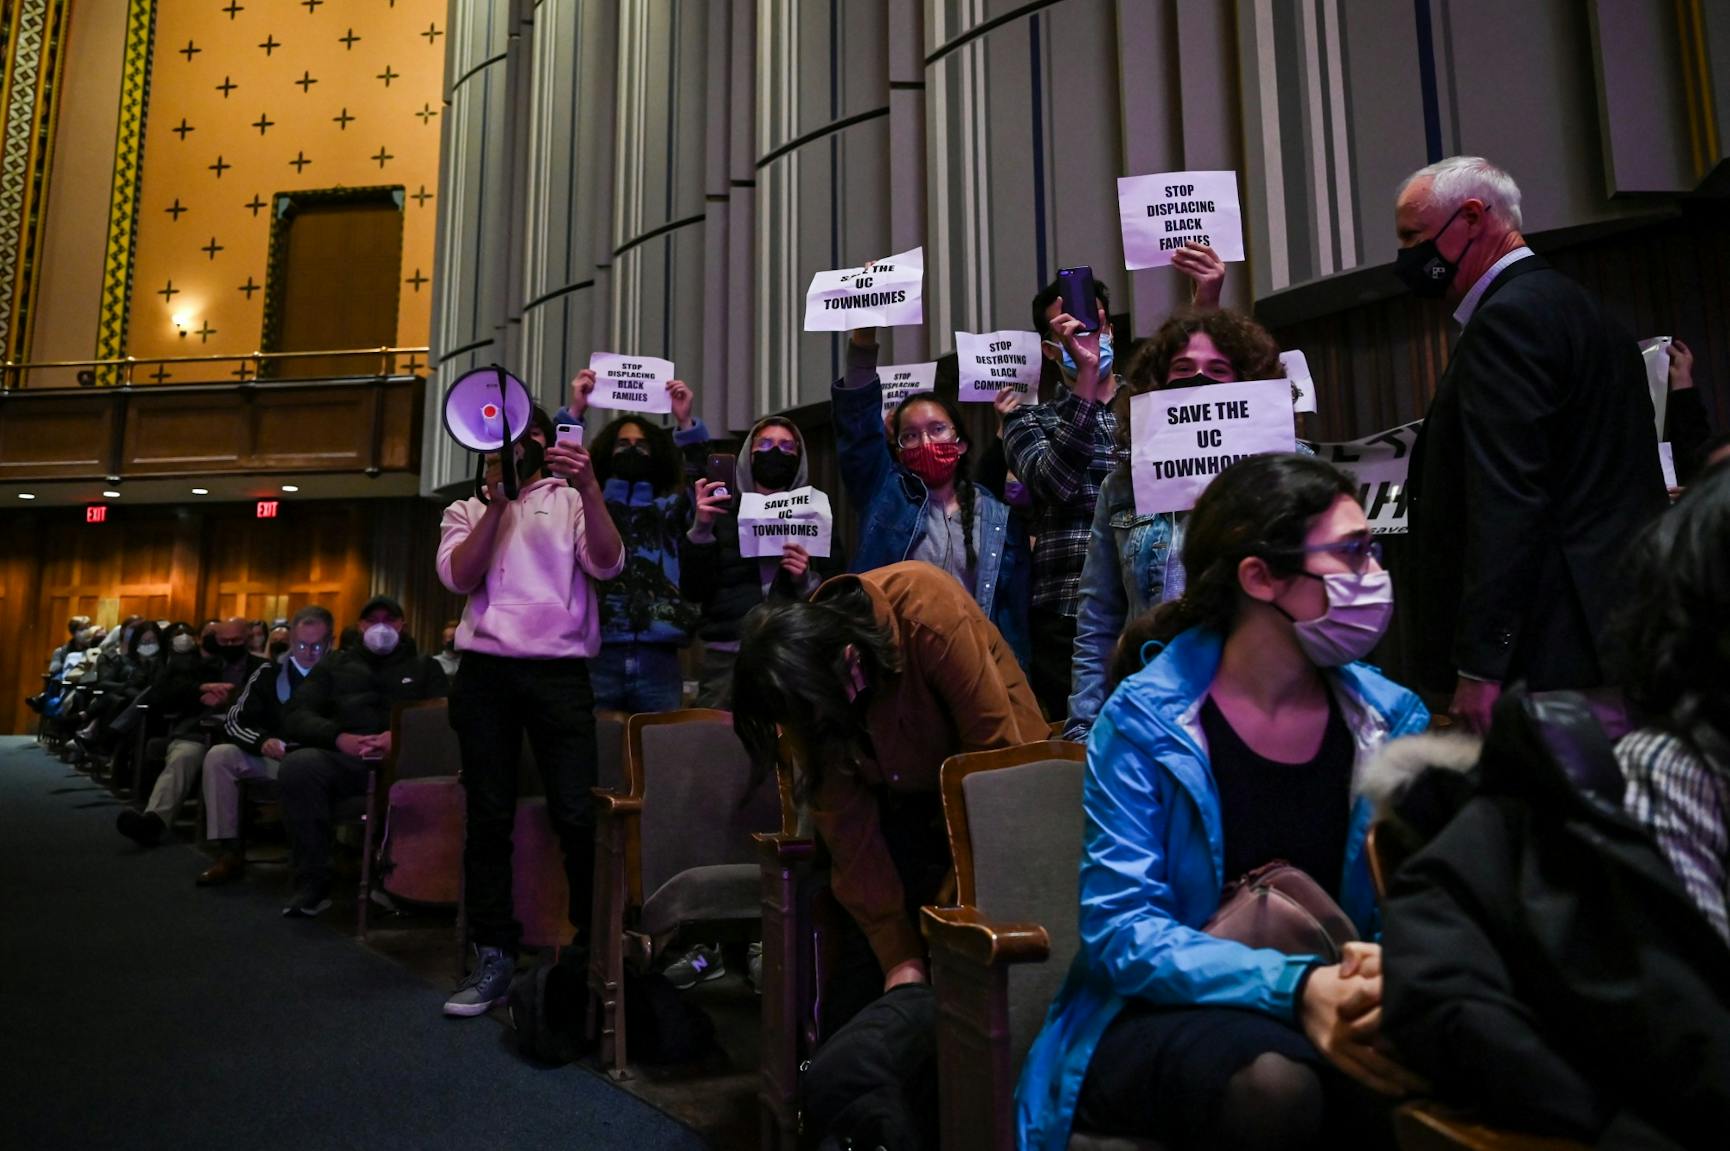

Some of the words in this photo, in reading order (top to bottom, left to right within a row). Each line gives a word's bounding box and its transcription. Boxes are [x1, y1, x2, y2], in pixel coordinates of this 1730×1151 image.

[1165, 184, 1194, 198] STOP
[1147, 201, 1215, 217] DISPLACING
[1165, 218, 1202, 232] BLACK
[1159, 235, 1210, 251] FAMIIES
[872, 264, 895, 273] THE
[856, 277, 873, 289] UC
[824, 290, 906, 310] TOWNHOMES
[989, 341, 1012, 352] STOP
[976, 354, 1027, 365] DESTROYING
[608, 370, 656, 379] DISPLACING
[894, 372, 911, 381] STOP
[990, 368, 1017, 378] BLACK
[618, 380, 644, 390] BLACK
[612, 391, 648, 402] FAMILIES
[1167, 403, 1212, 425] SAVE
[1215, 400, 1249, 420] THE
[1197, 429, 1222, 448] UC
[1153, 454, 1254, 480] TOWNHO
[764, 499, 789, 510] SAVE
[791, 495, 809, 505] THE
[86, 506, 107, 522] EXIT
[256, 501, 278, 518] EXIT
[778, 509, 793, 519] UC
[752, 524, 818, 537] TOWNHOMES
